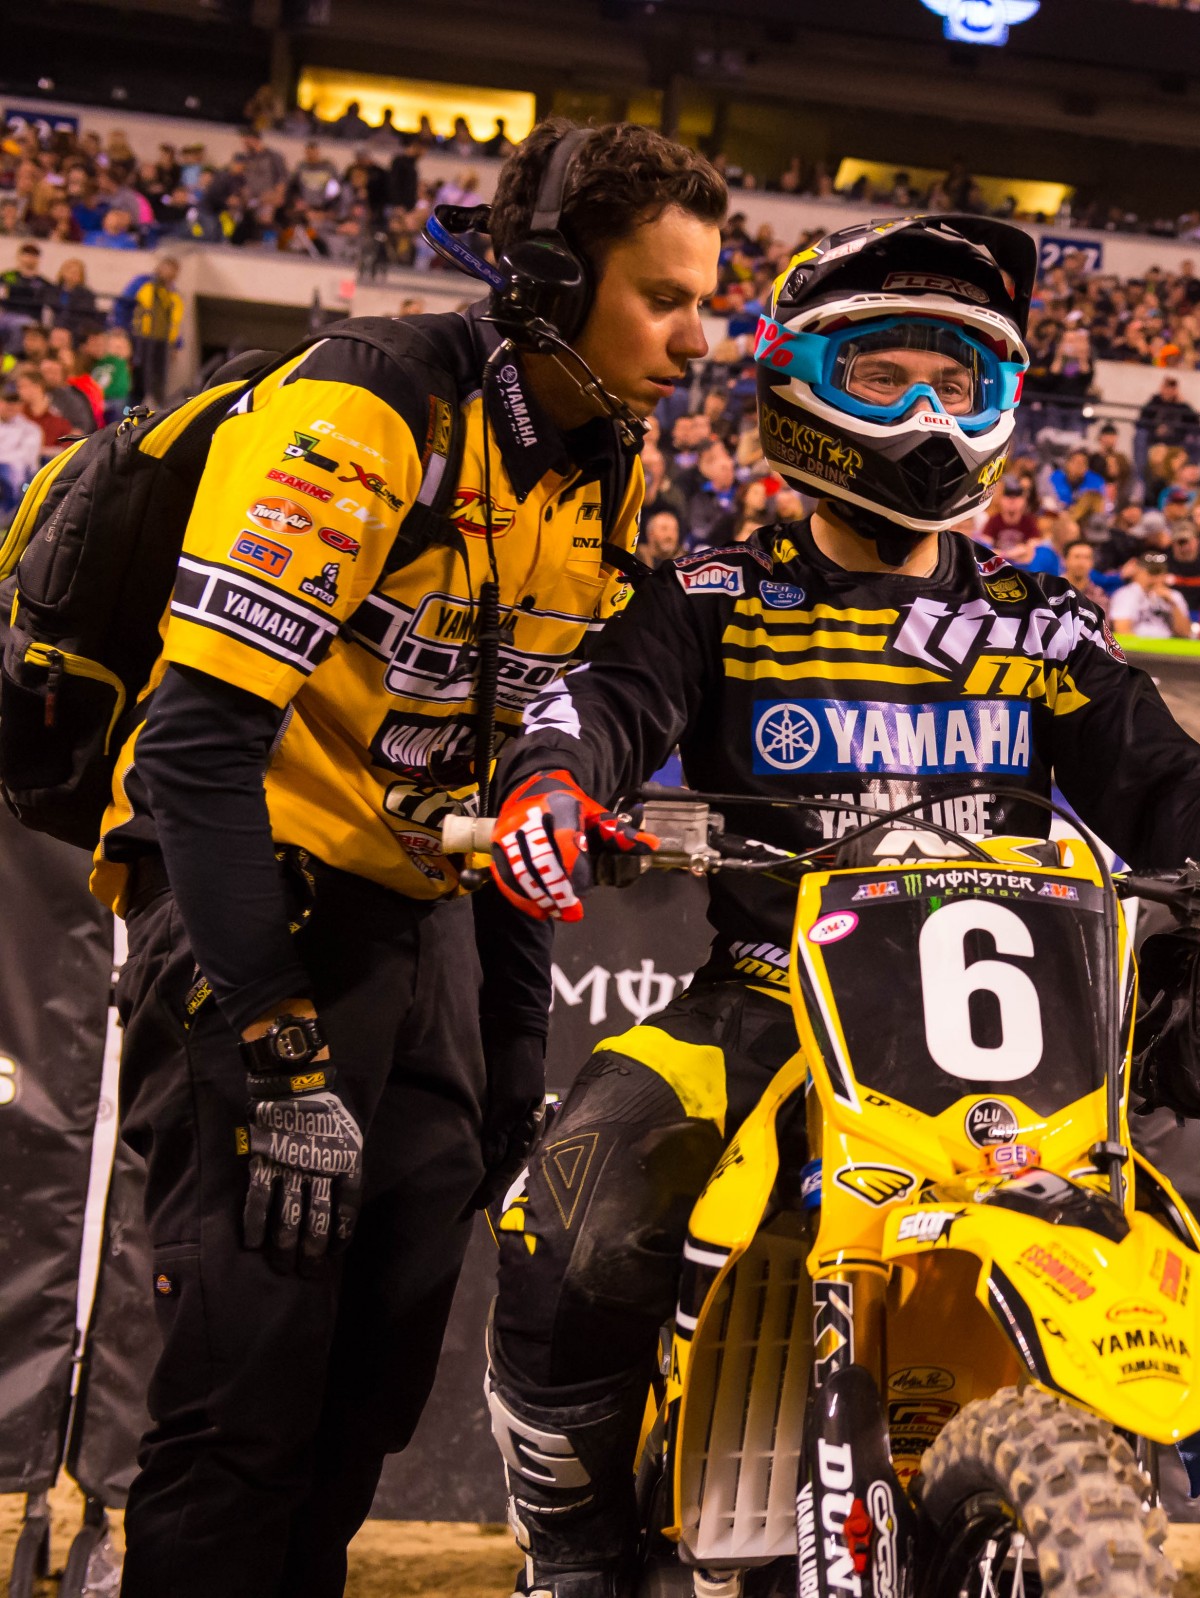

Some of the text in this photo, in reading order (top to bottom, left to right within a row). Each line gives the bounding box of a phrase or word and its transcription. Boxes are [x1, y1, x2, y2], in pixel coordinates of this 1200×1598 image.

[451, 243, 503, 285] STERLING
[885, 272, 963, 290] FLEX
[506, 382, 538, 448] YAMAHA
[924, 415, 952, 427] BELL
[266, 469, 333, 502] BRAKING
[806, 457, 850, 489] DRINK
[236, 539, 286, 567] GET
[573, 536, 601, 549] UNL
[301, 581, 335, 604] enzo
[688, 569, 735, 591] 100%
[222, 590, 307, 647] YAMAHA
[824, 706, 1030, 768] YAMAHA
[815, 792, 993, 840] YAMALUBE
[853, 880, 900, 901] AMA
[925, 869, 1036, 891] MONSTER
[944, 887, 1022, 898] ENERGY
[1038, 881, 1079, 901] AMA
[919, 899, 1044, 1082] 6
[255, 1101, 346, 1140] Mechanix
[974, 1106, 1000, 1124] bLU
[270, 1132, 358, 1175] Mechanix
[1091, 1329, 1191, 1360] YAMAHA
[796, 1481, 820, 1598] YAMALUB
